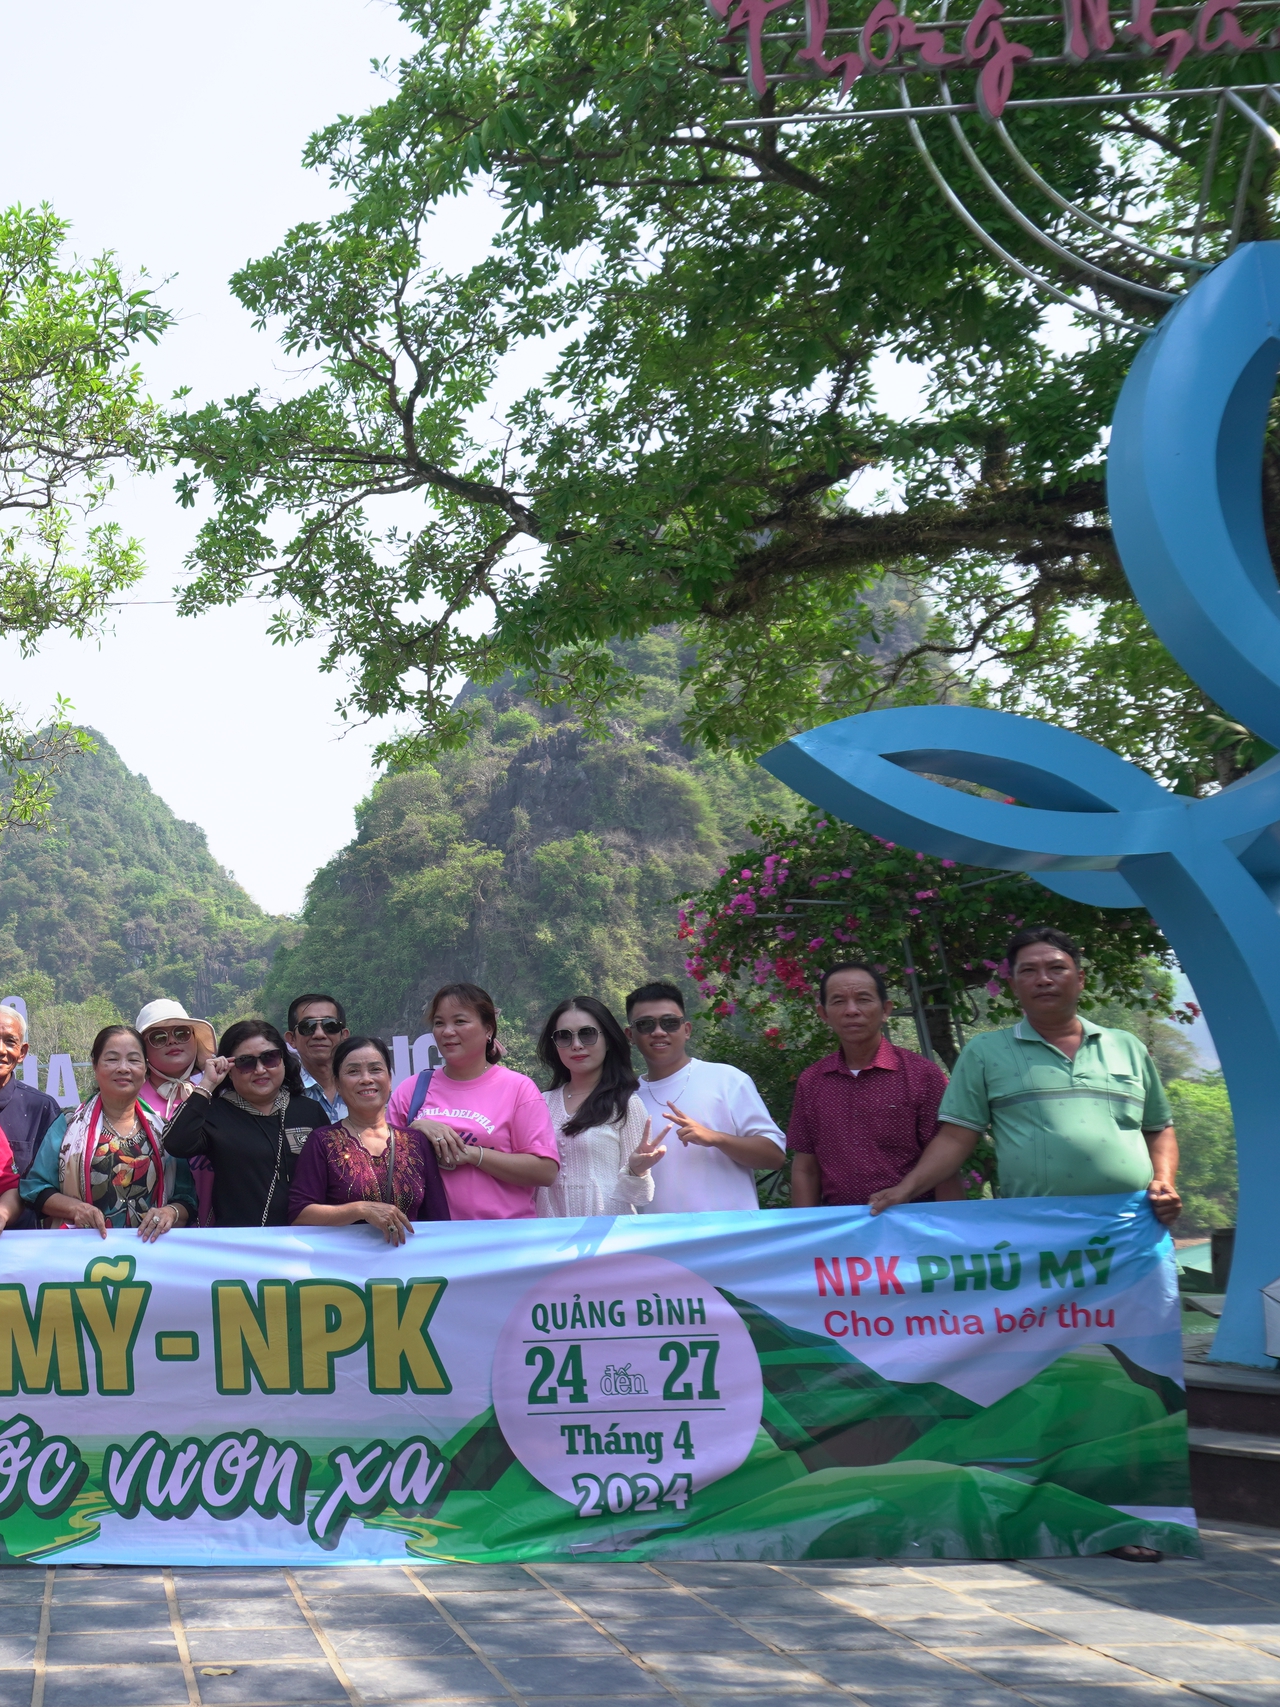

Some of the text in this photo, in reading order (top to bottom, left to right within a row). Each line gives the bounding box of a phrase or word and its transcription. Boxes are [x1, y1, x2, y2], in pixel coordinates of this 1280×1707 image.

[414, 1107, 495, 1135] PHILADELPHIA
[814, 1235, 1116, 1297] NPK PHÚ MỸ
[212, 1278, 451, 1394] NPK
[531, 1293, 707, 1334] QUẢNG BÌNH
[824, 1302, 1115, 1337] Cho mùa bội thu
[525, 1340, 720, 1404] 24 đến 27
[560, 1421, 695, 1464] Tháng 4
[106, 1433, 302, 1515] vươn
[311, 1439, 447, 1541] xa
[573, 1473, 693, 1519] 2024
